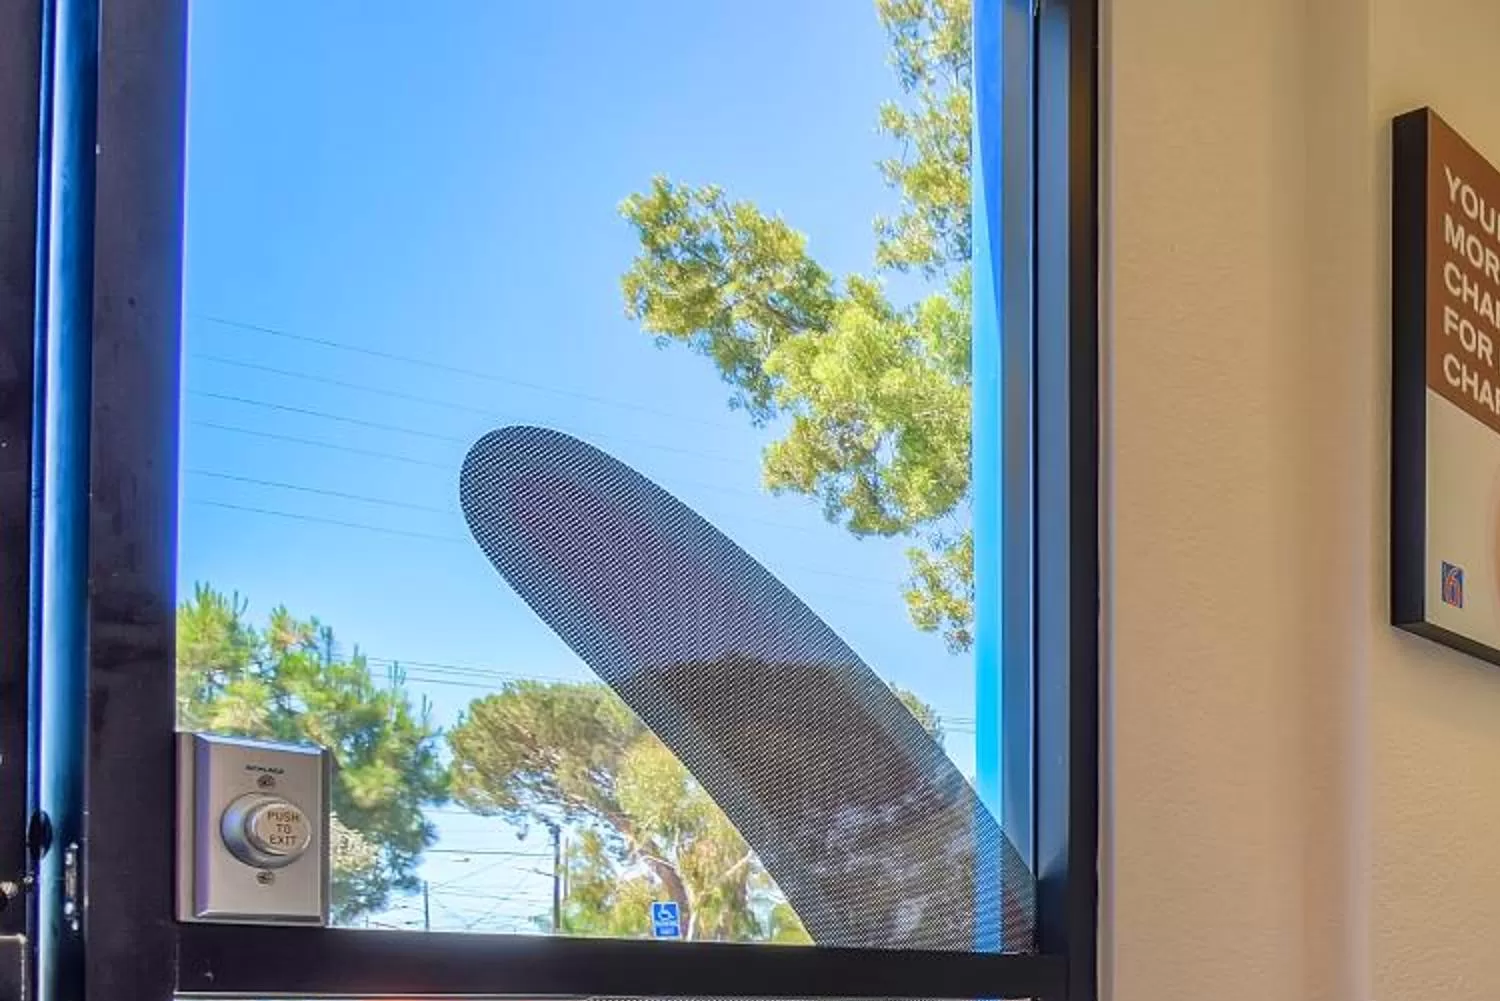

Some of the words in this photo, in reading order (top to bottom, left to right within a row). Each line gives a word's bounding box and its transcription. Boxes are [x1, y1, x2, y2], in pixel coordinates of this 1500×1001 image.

[1443, 305, 1494, 367] FOR
[267, 811, 299, 822] PUSH
[276, 823, 292, 834] TO
[269, 834, 297, 846] EXIT
